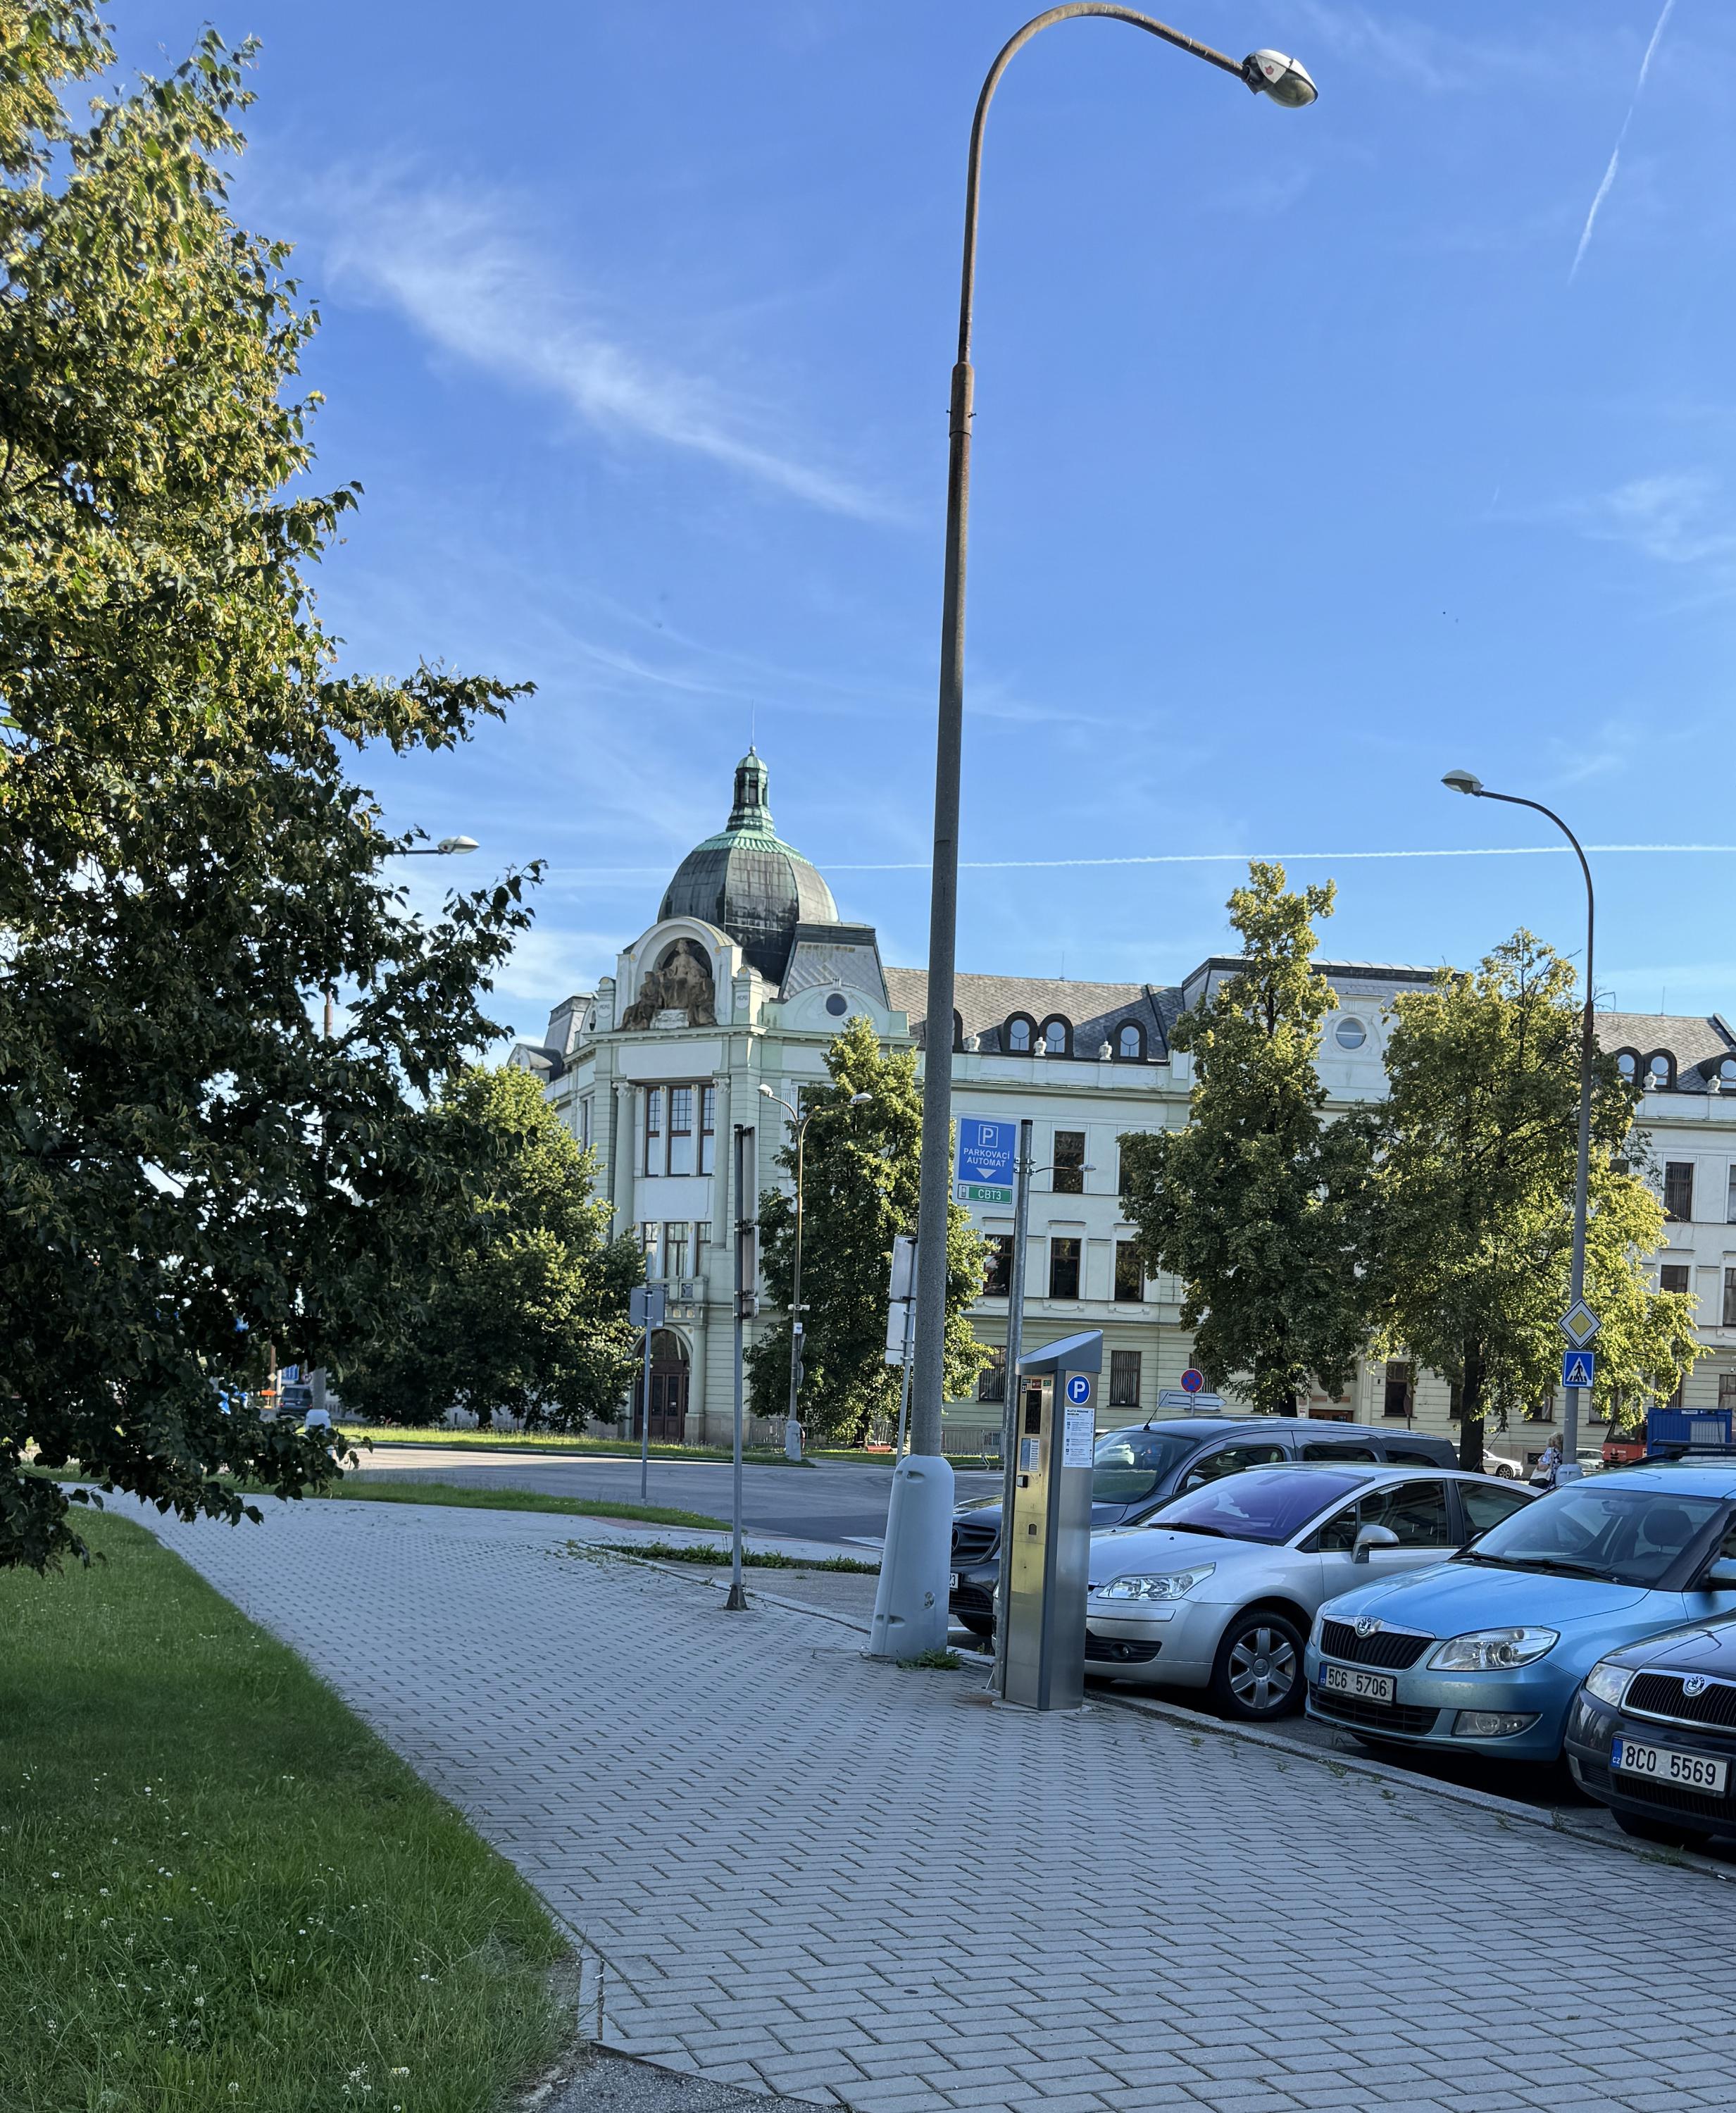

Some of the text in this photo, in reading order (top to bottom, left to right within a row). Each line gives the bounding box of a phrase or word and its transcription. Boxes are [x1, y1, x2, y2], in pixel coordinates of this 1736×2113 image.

[982, 1126, 994, 1145] P
[963, 1147, 1010, 1160] PARKOVACÍ
[966, 1157, 1006, 1167] AUTOMAT
[978, 1188, 1001, 1200] CBT3
[1074, 1381, 1085, 1398] P
[1328, 1668, 1387, 1697] 5C6 5706
[1625, 1745, 1716, 1785] 8C0 5569
